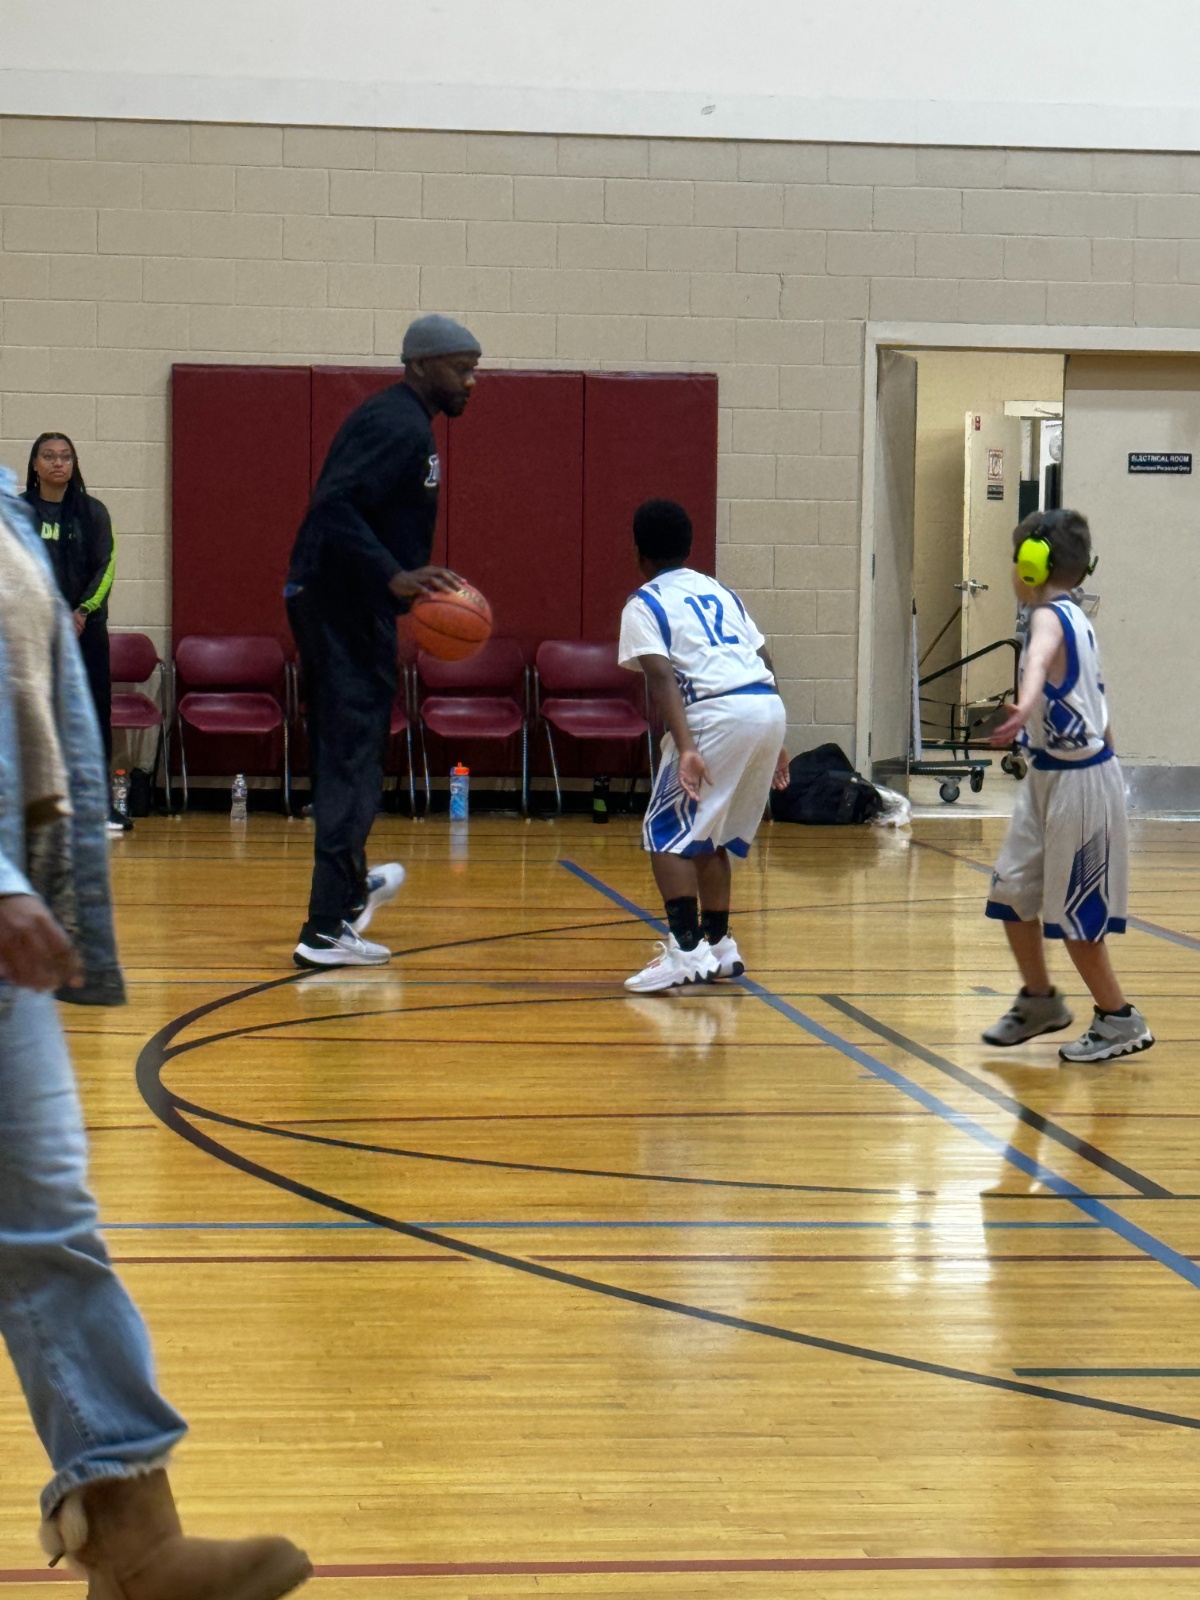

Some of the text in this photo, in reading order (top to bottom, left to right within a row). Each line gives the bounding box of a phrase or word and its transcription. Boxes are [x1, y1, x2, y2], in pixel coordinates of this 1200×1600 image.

[1131, 455, 1189, 463] ELECTRICAL ROOM
[684, 593, 739, 647] 12
